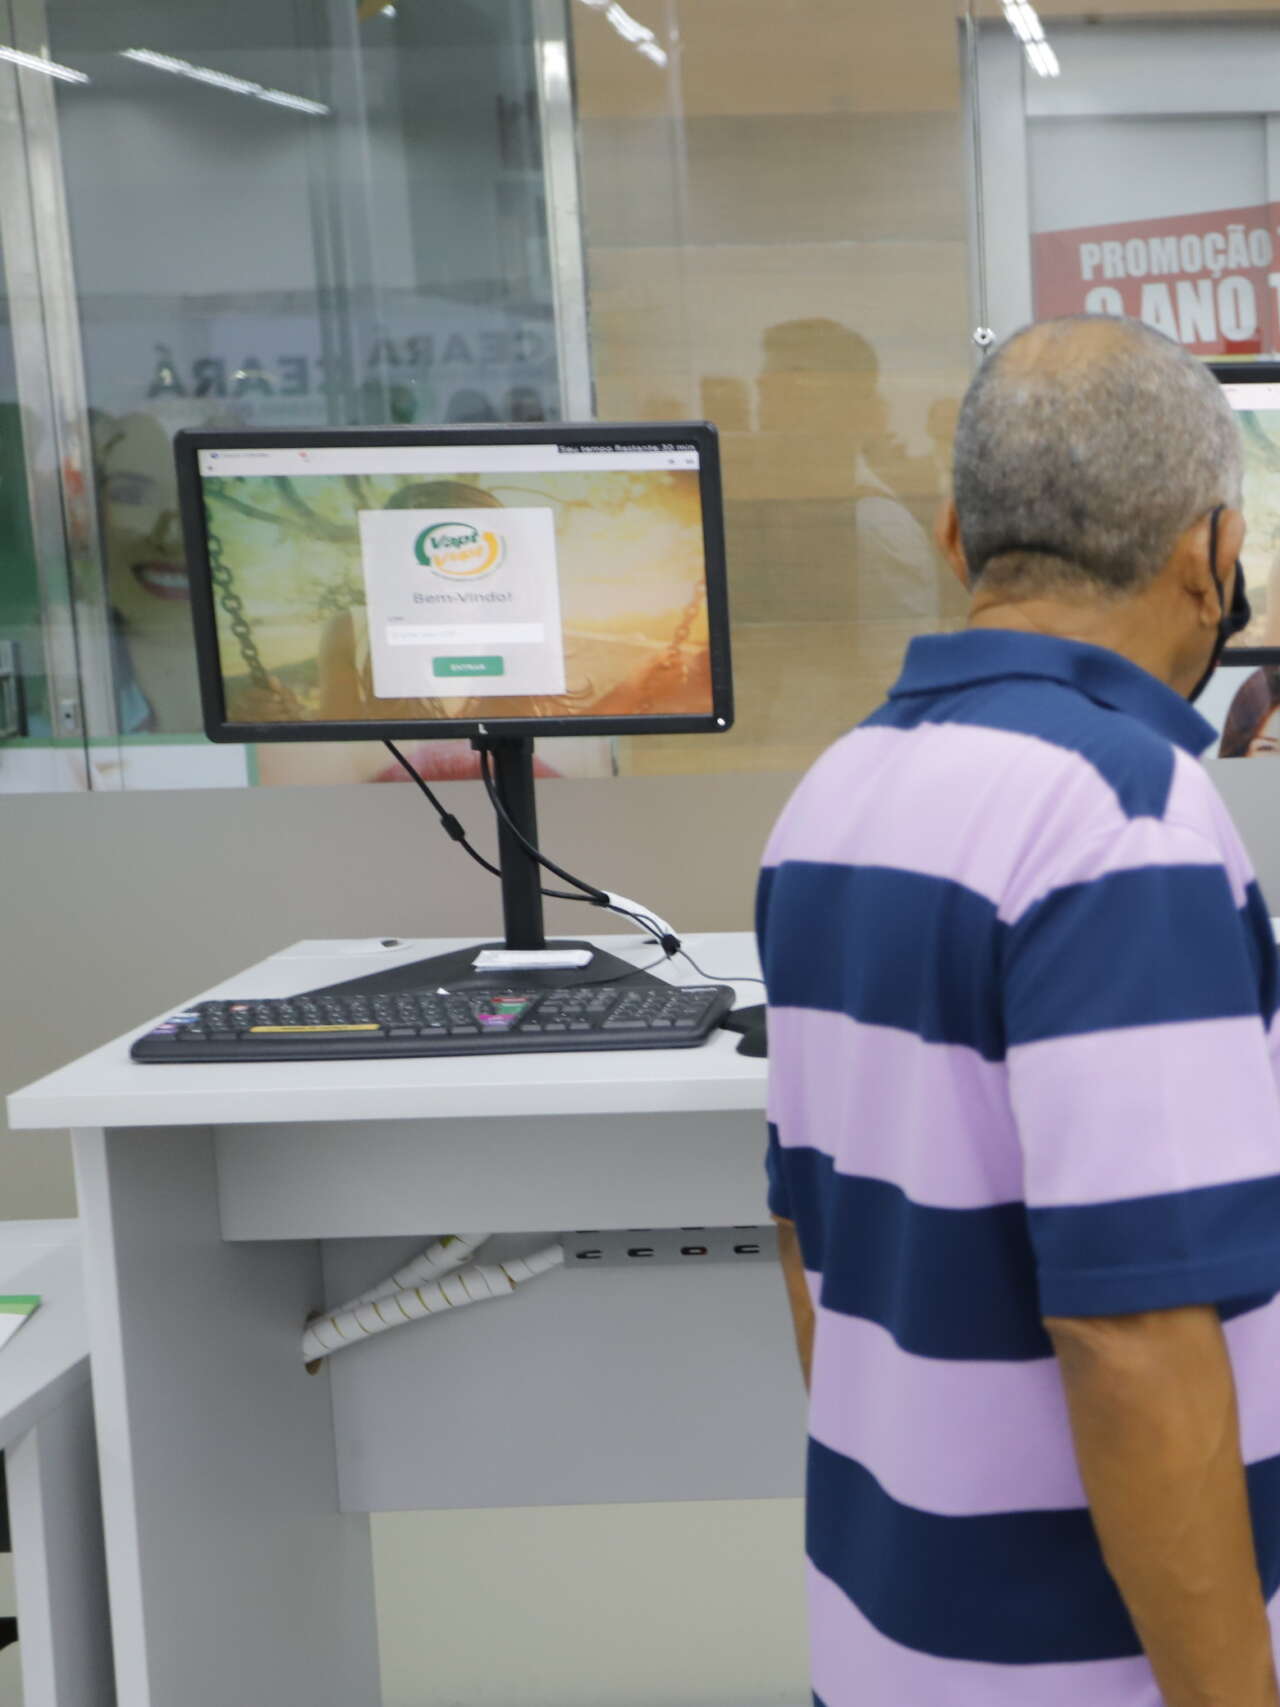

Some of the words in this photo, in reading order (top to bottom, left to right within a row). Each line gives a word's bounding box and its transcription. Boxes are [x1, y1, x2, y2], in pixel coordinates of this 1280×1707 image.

[1080, 224, 1272, 281] PROMOÇÃO
[1141, 275, 1257, 344] ANO
[413, 591, 512, 605] Bem-Vindo!
